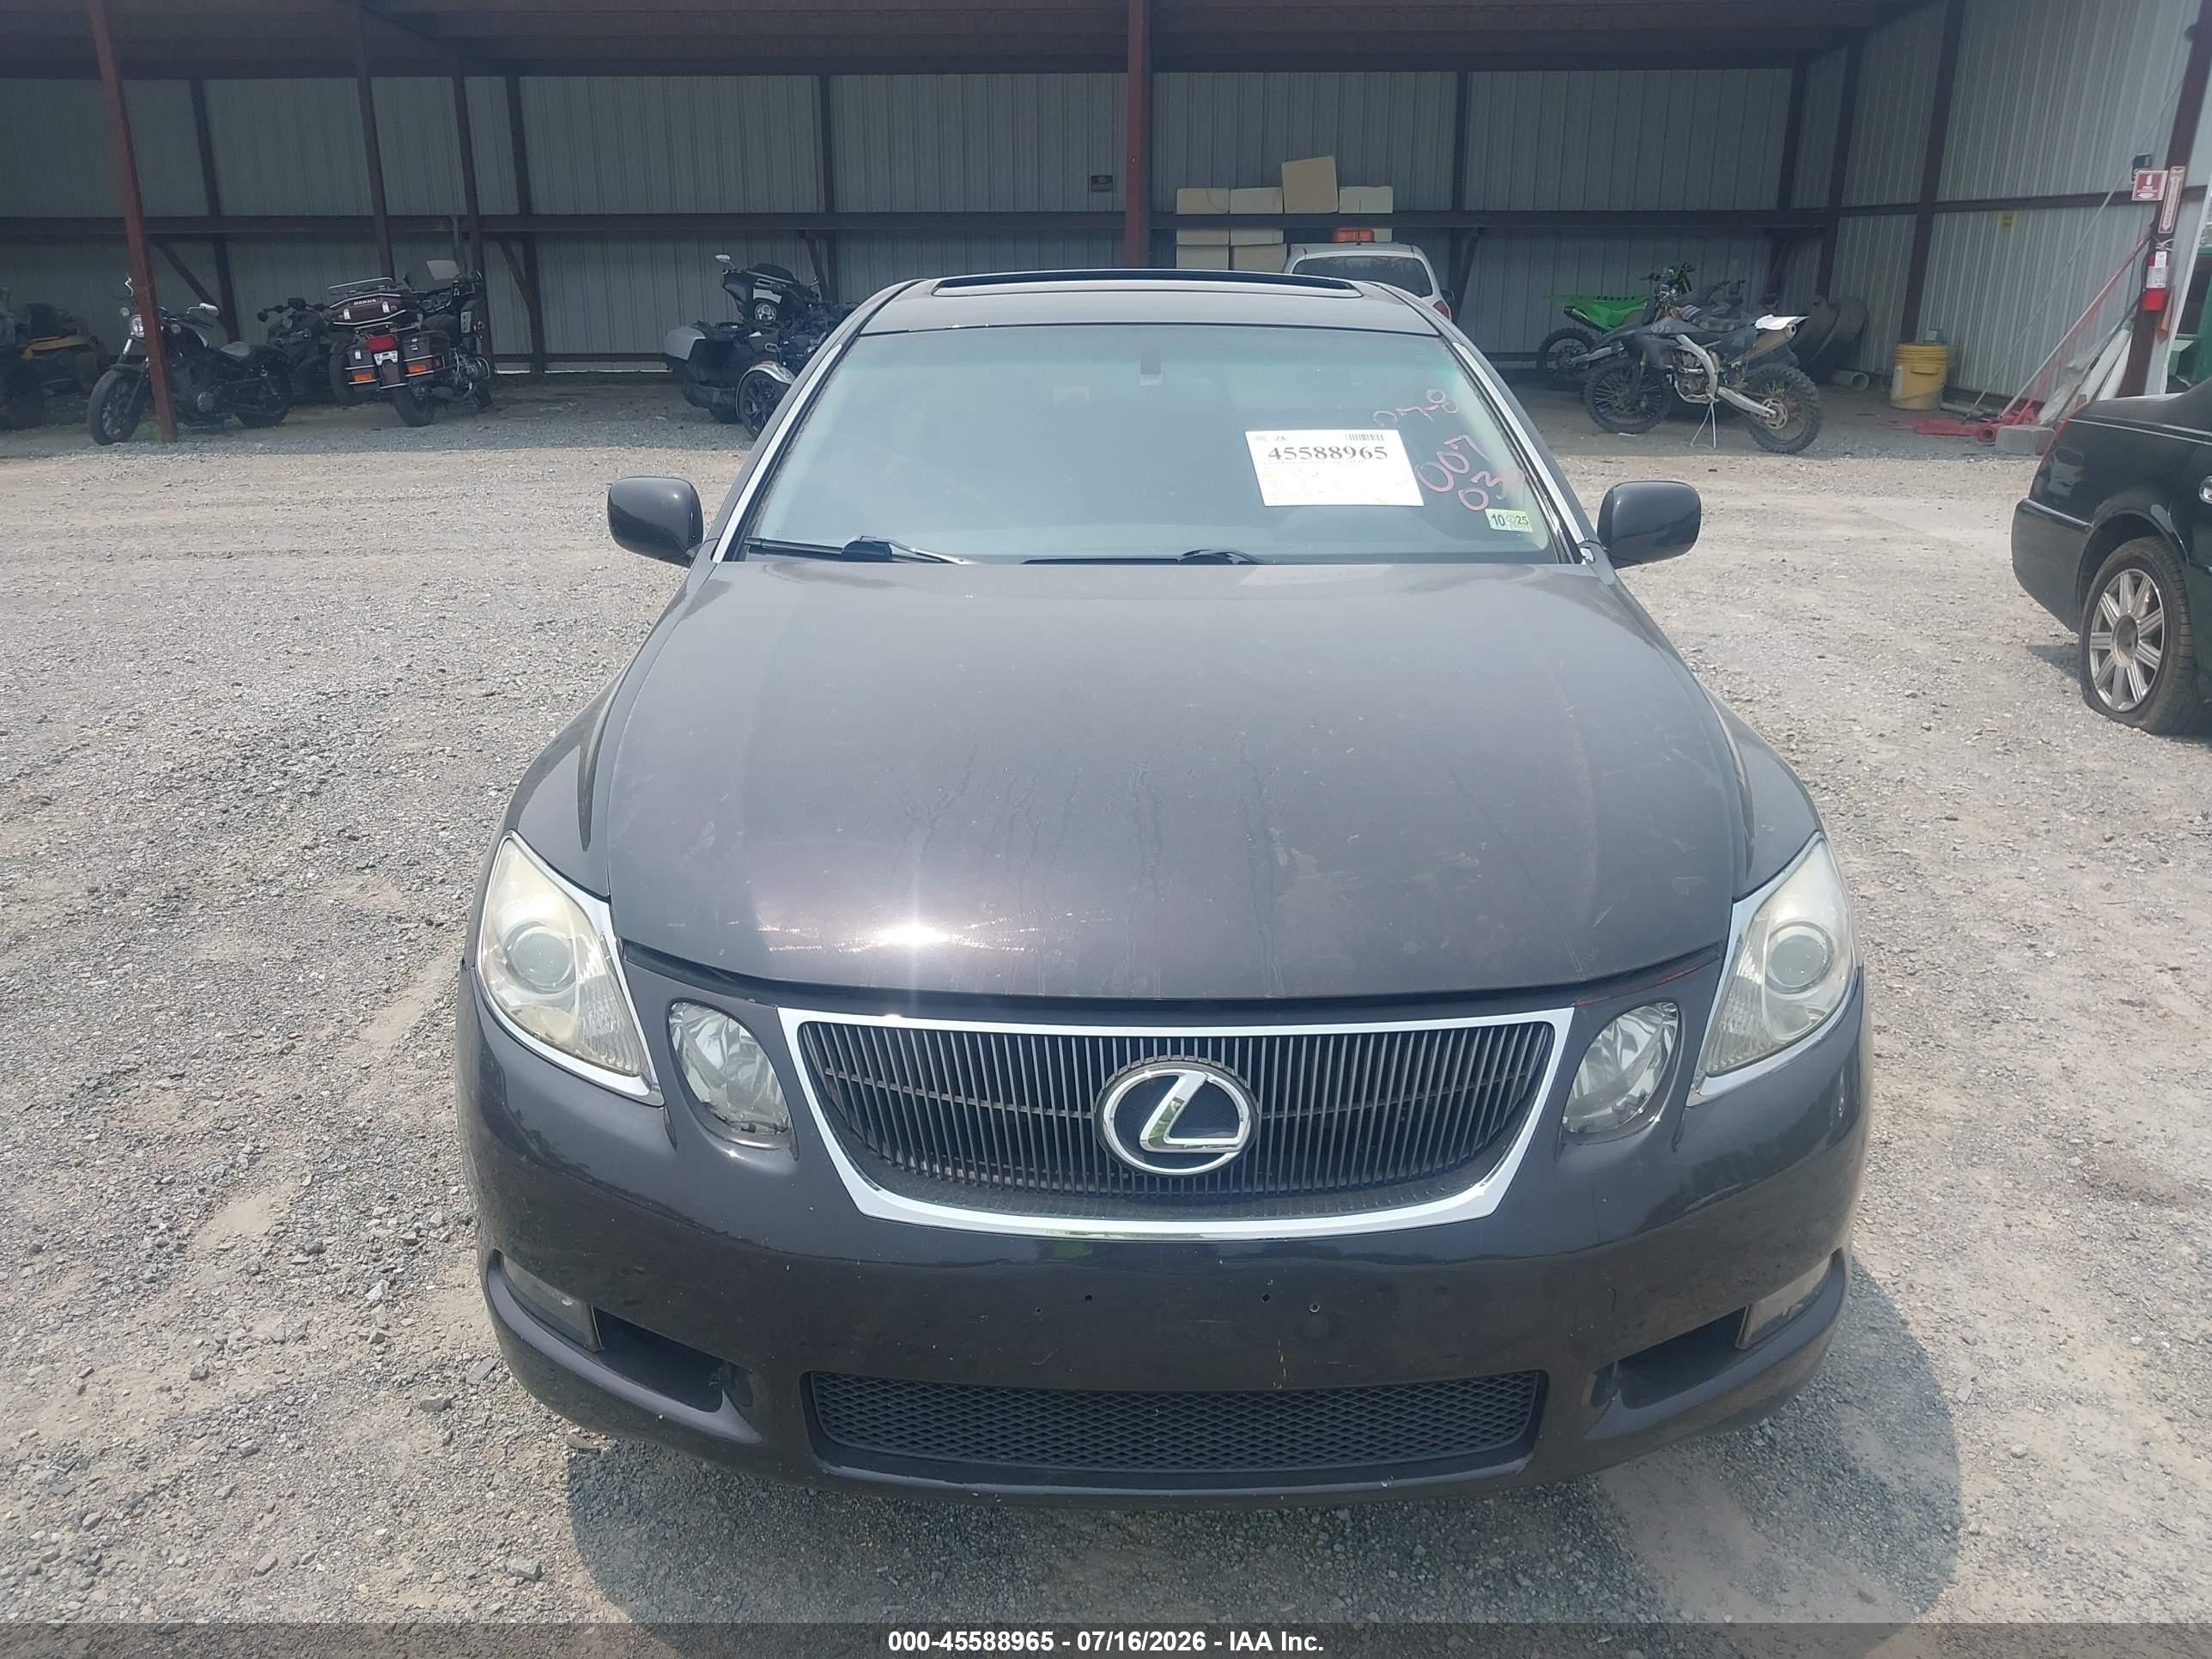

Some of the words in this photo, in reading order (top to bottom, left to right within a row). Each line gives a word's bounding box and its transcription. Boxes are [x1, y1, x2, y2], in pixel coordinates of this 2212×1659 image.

[1267, 446, 1389, 460] 45588965
[1491, 514, 1505, 526] 10
[1516, 515, 1528, 526] 25
